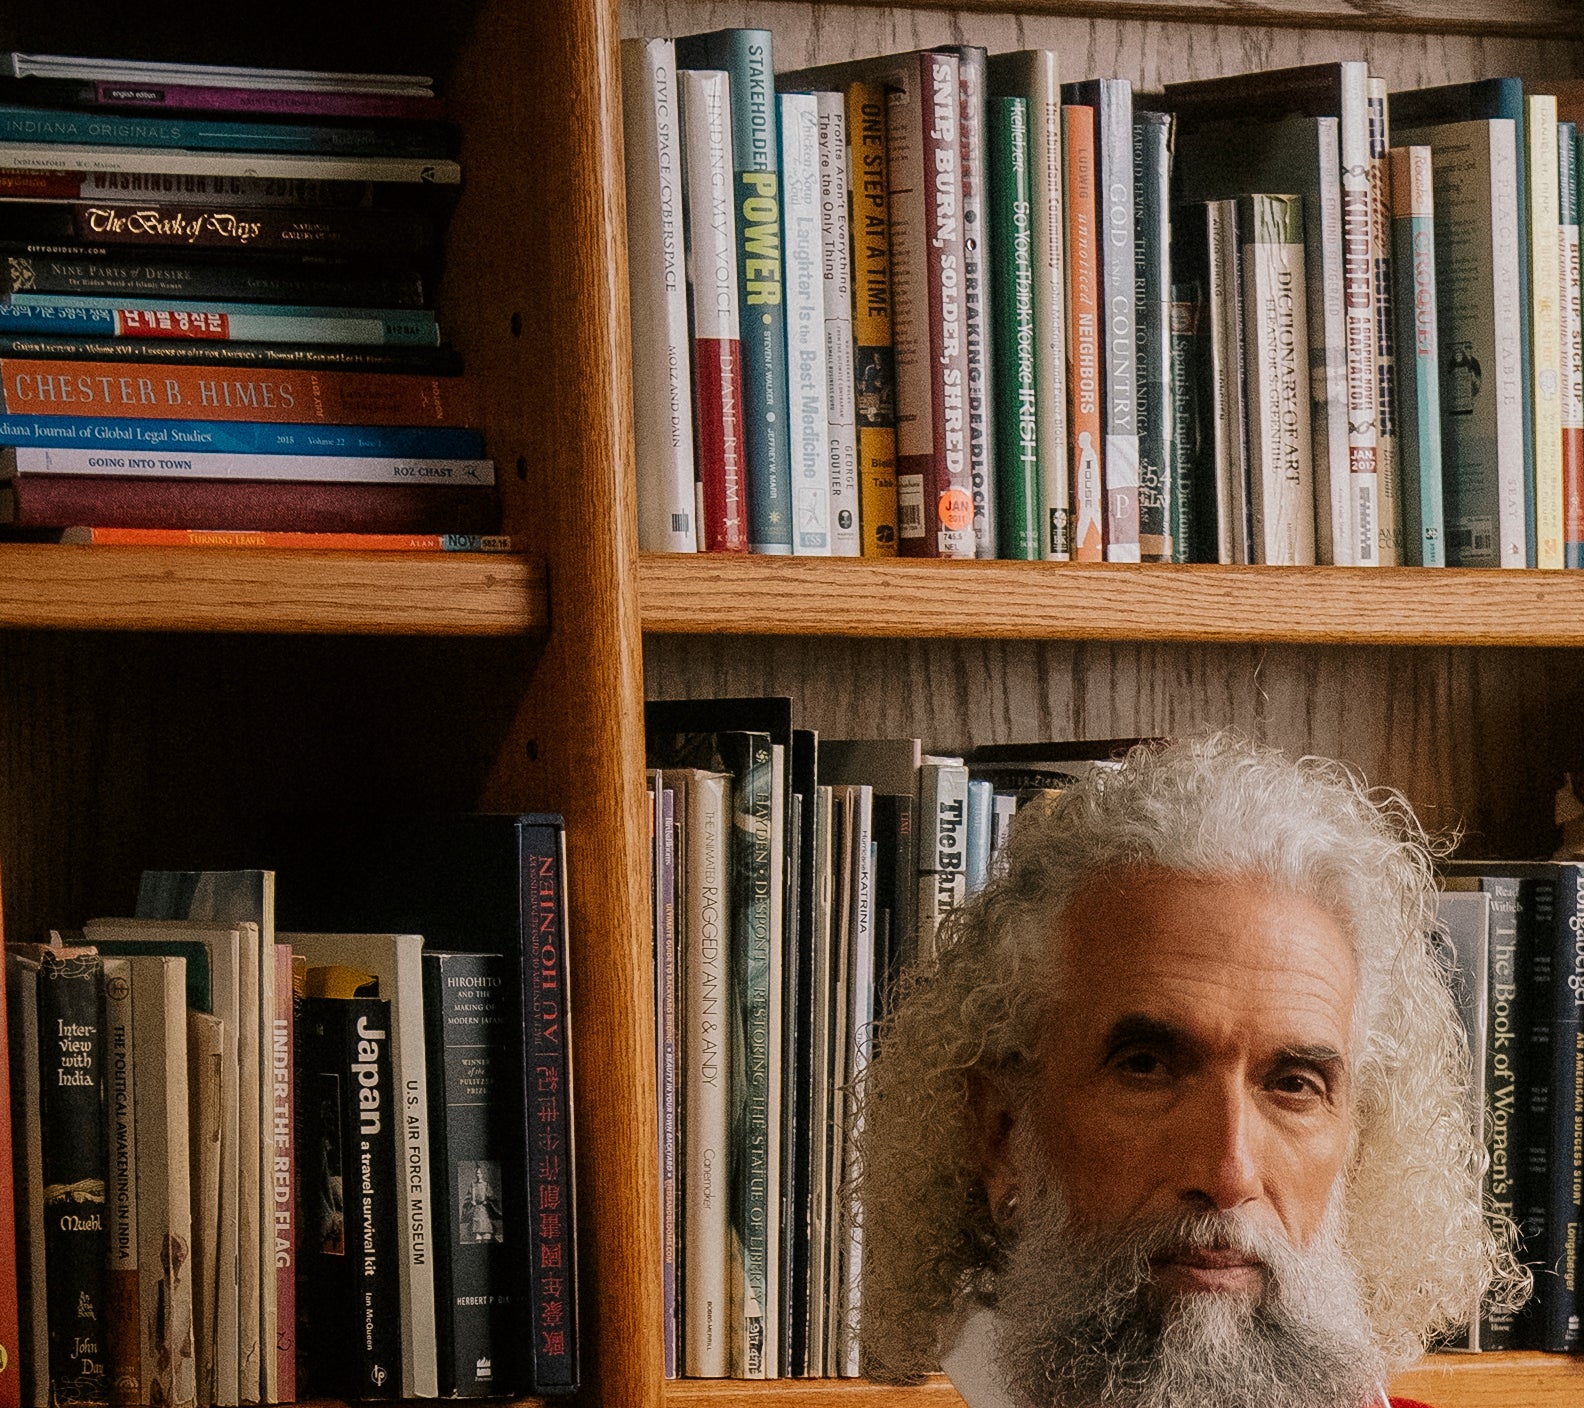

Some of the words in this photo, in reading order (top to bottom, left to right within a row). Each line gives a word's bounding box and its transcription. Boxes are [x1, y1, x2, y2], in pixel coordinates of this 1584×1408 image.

[656, 66, 668, 117] CIVIC
[748, 44, 768, 171] STAKEHOLDER
[931, 63, 954, 142] SNIP,
[6, 121, 78, 135] INDIANA
[88, 124, 182, 139] ORIGINALS
[932, 149, 956, 247] BURN,
[1078, 148, 1088, 198] LUDWIG
[85, 208, 127, 233] The
[127, 211, 186, 235] Book
[187, 213, 207, 243] of
[206, 213, 262, 244] Days
[658, 123, 676, 292] SPACE/CYBERSPACE
[1110, 184, 1128, 248] GOD
[742, 172, 781, 305] POWER
[1078, 213, 1093, 306] unnoticed
[1344, 190, 1370, 308] KINDRED
[940, 254, 962, 364] SOLDER,
[1414, 230, 1434, 360] CROQUET
[1079, 313, 1094, 414] NEIGHBORS
[1112, 296, 1131, 430] COUNTRY
[1278, 272, 1298, 406] DICTIONARY
[1348, 316, 1363, 411] ADAPTATION
[15, 374, 157, 404] CHESTER
[165, 379, 192, 406] B.
[201, 381, 295, 408] HIMES
[944, 369, 964, 473] SHRED
[1283, 410, 1298, 439] OF
[88, 457, 125, 468] GOING
[128, 459, 155, 469] INTO
[159, 460, 192, 470] TOWN
[394, 467, 415, 476] ROZ
[418, 468, 452, 477] CHAST
[830, 439, 841, 496] CLOUTIER
[1284, 444, 1300, 486] ART
[449, 535, 476, 547] NOV
[705, 811, 715, 830] THE
[754, 792, 768, 864] HAYDEN
[705, 831, 715, 884] ANIMATED
[702, 886, 718, 967] RAGGEDY
[754, 880, 768, 963] DESPONT
[859, 871, 868, 934] KATRINA
[1494, 917, 1517, 979] The
[702, 971, 718, 1015] ANN
[1494, 982, 1515, 1048] Book
[57, 1019, 97, 1040] Inter-
[58, 1039, 92, 1052] view
[114, 1026, 125, 1049] THE
[702, 1020, 717, 1034] &
[752, 986, 767, 1085] RESTORING
[1576, 1031, 1584, 1049] AN
[58, 1069, 94, 1086] India
[61, 1052, 92, 1068] with
[114, 1052, 127, 1117] POLITICAL
[272, 1018, 288, 1099] UNDER
[702, 1038, 717, 1089] ANDY
[1494, 1052, 1515, 1081] of
[1574, 1052, 1584, 1113] AMERICAN
[406, 1079, 418, 1110] U.S.
[751, 1097, 765, 1129] THE
[273, 1103, 289, 1149] THE
[407, 1115, 420, 1141] AIR
[1493, 1086, 1515, 1194] Women's
[1573, 1115, 1584, 1167] SUCCESS
[116, 1122, 128, 1202] AWAKENING
[273, 1156, 290, 1203] RED
[409, 1146, 422, 1194] FORCE
[703, 1148, 716, 1210] Canemaker
[750, 1135, 763, 1200] STATUE
[1572, 1169, 1582, 1206] STORY
[118, 1204, 129, 1220] IN
[274, 1210, 290, 1269] FLAG
[412, 1198, 424, 1266] MUSEUM
[750, 1206, 763, 1226] OF
[118, 1222, 130, 1260] INDIA
[749, 1236, 763, 1304] LIBERTY
